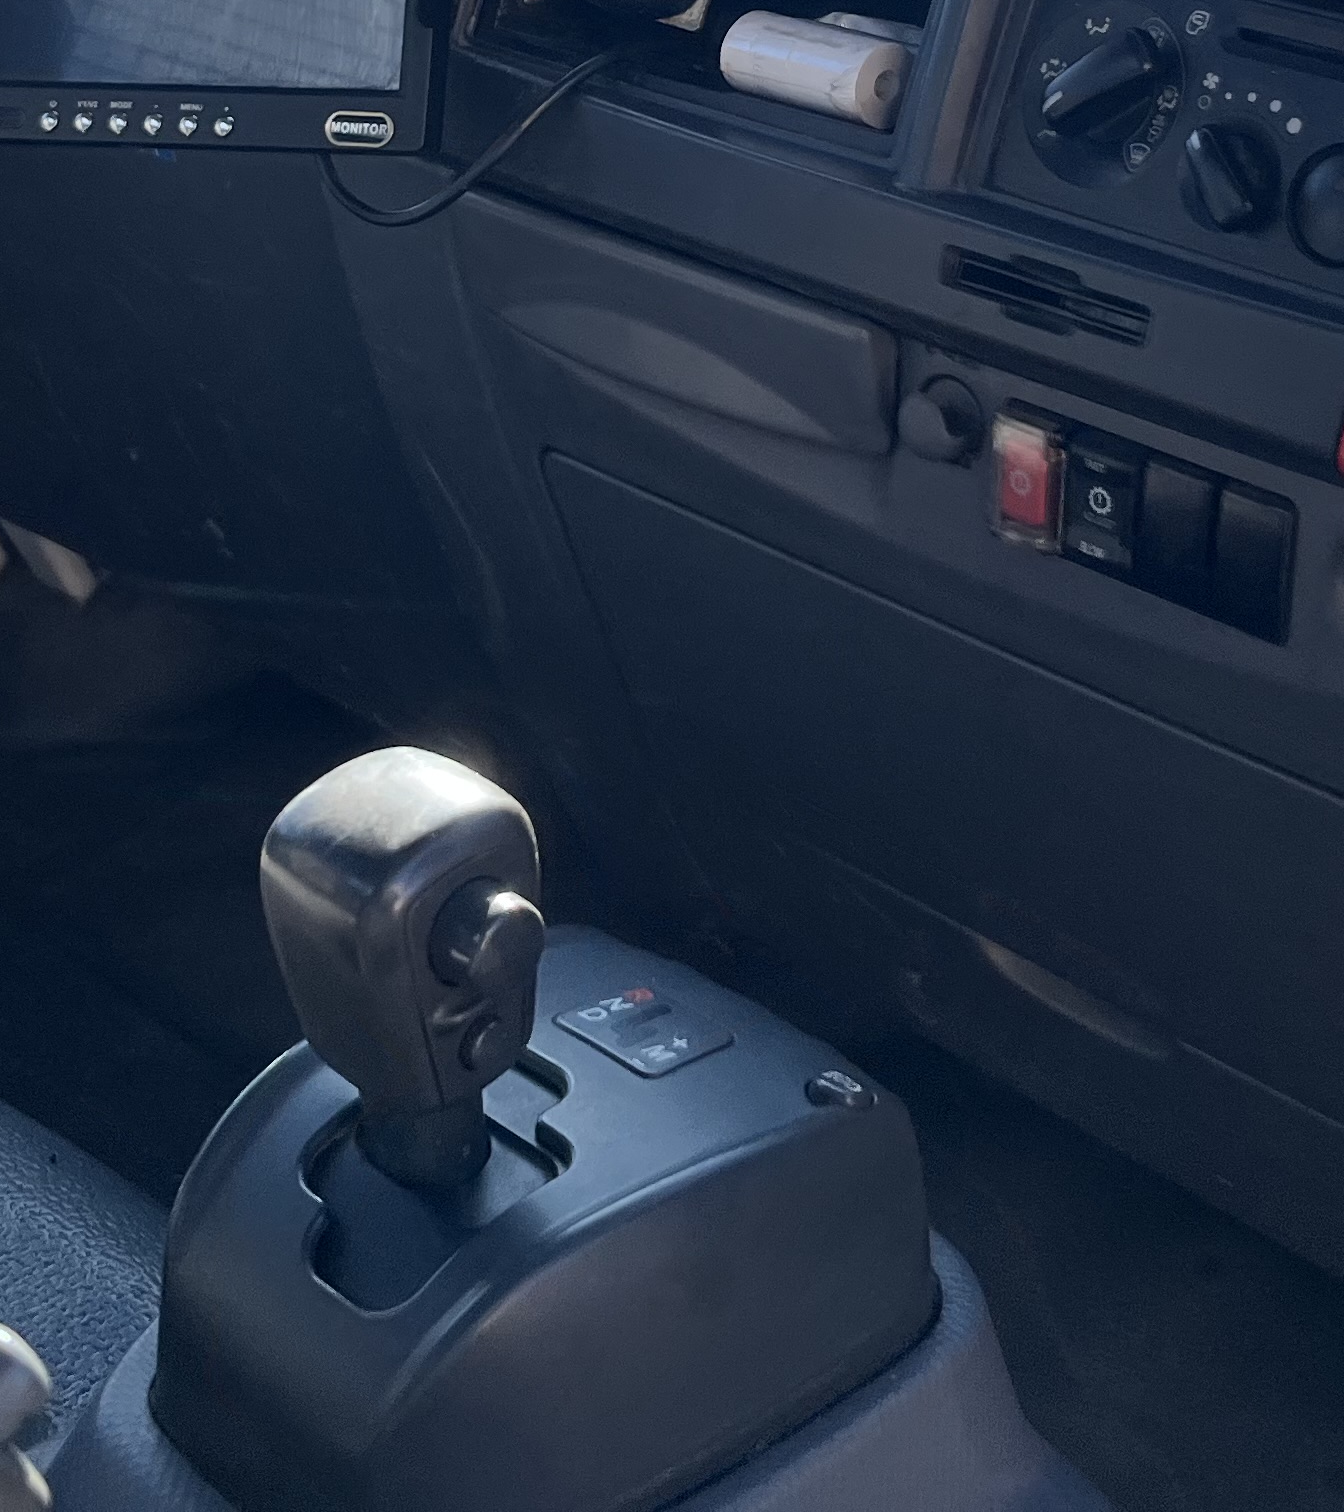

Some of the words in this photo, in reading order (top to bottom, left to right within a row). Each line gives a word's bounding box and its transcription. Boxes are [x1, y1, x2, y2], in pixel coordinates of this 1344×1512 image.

[179, 103, 204, 111] MENU
[329, 121, 389, 137] MONITOR
[577, 1006, 608, 1022] D
